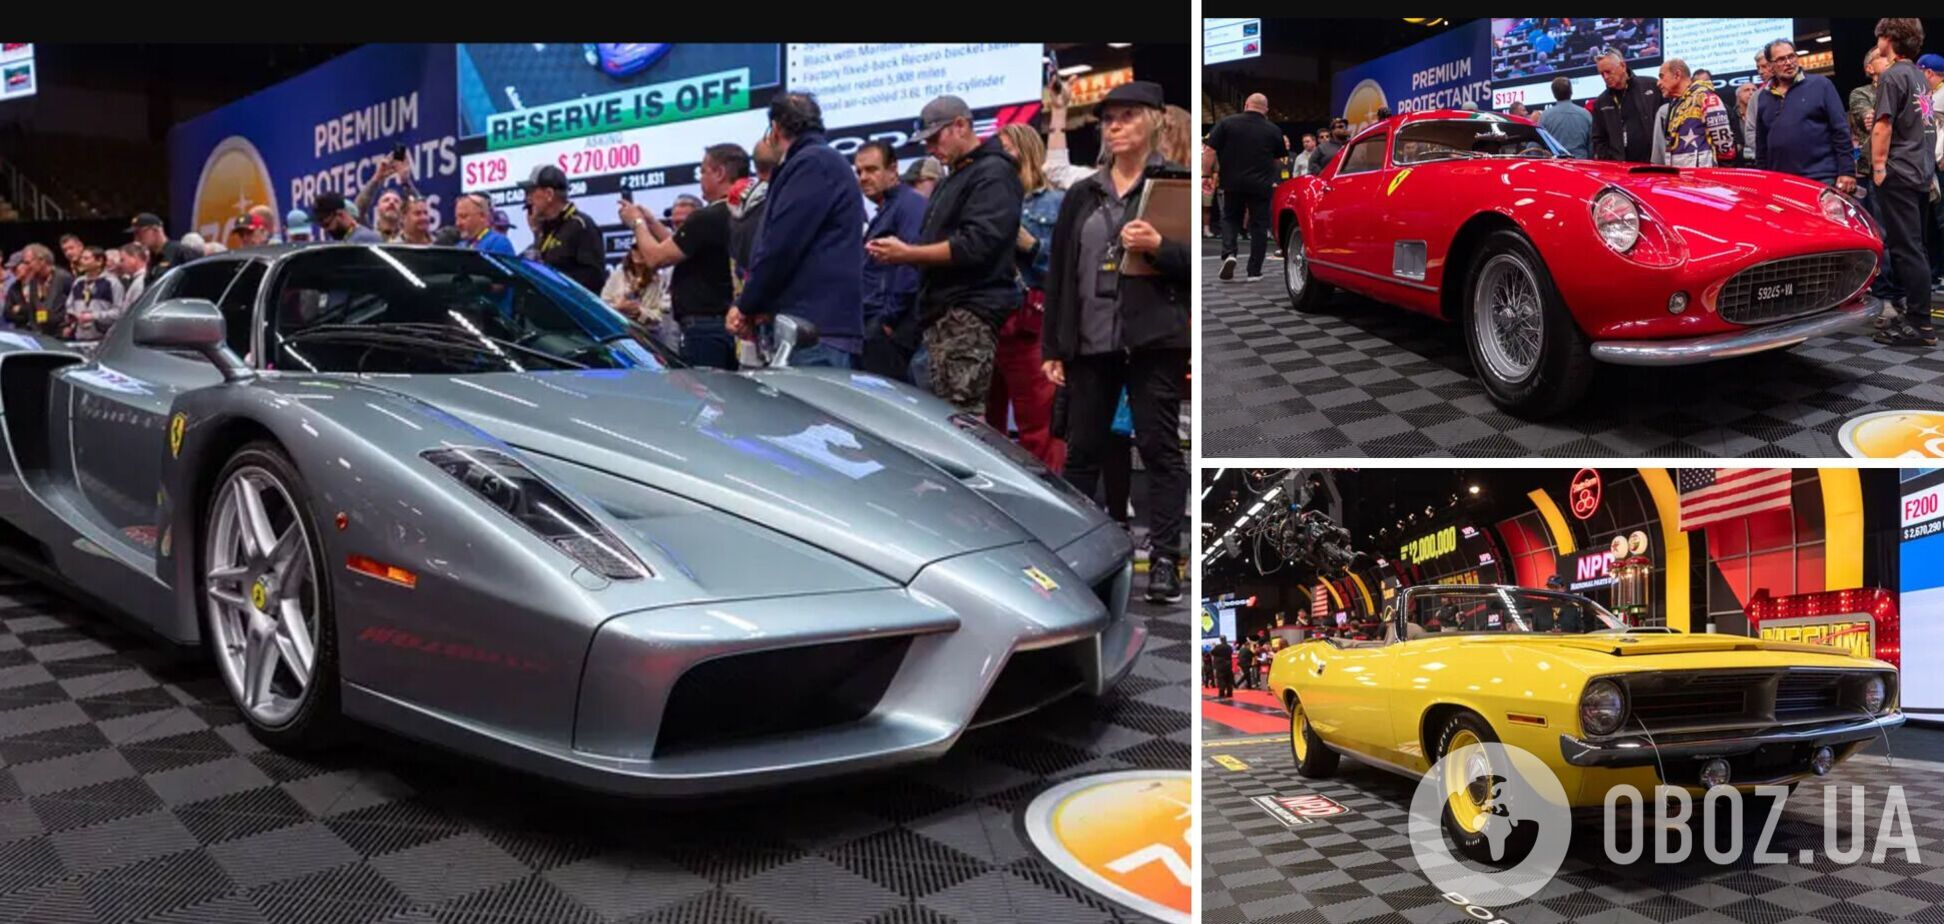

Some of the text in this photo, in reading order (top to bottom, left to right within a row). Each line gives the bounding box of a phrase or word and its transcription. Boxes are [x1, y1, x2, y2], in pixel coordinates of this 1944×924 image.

[1412, 57, 1472, 91] PREMIUM
[492, 75, 743, 143] RESERVE IS OFF
[1397, 79, 1493, 115] PROTECTANTS
[314, 91, 418, 158] PREMIUM
[572, 143, 641, 174] 270,000
[1904, 493, 1938, 521] F200
[1408, 525, 1457, 565] $2,000,000
[1577, 551, 1617, 581] NPD
[1441, 892, 1509, 924] DO
